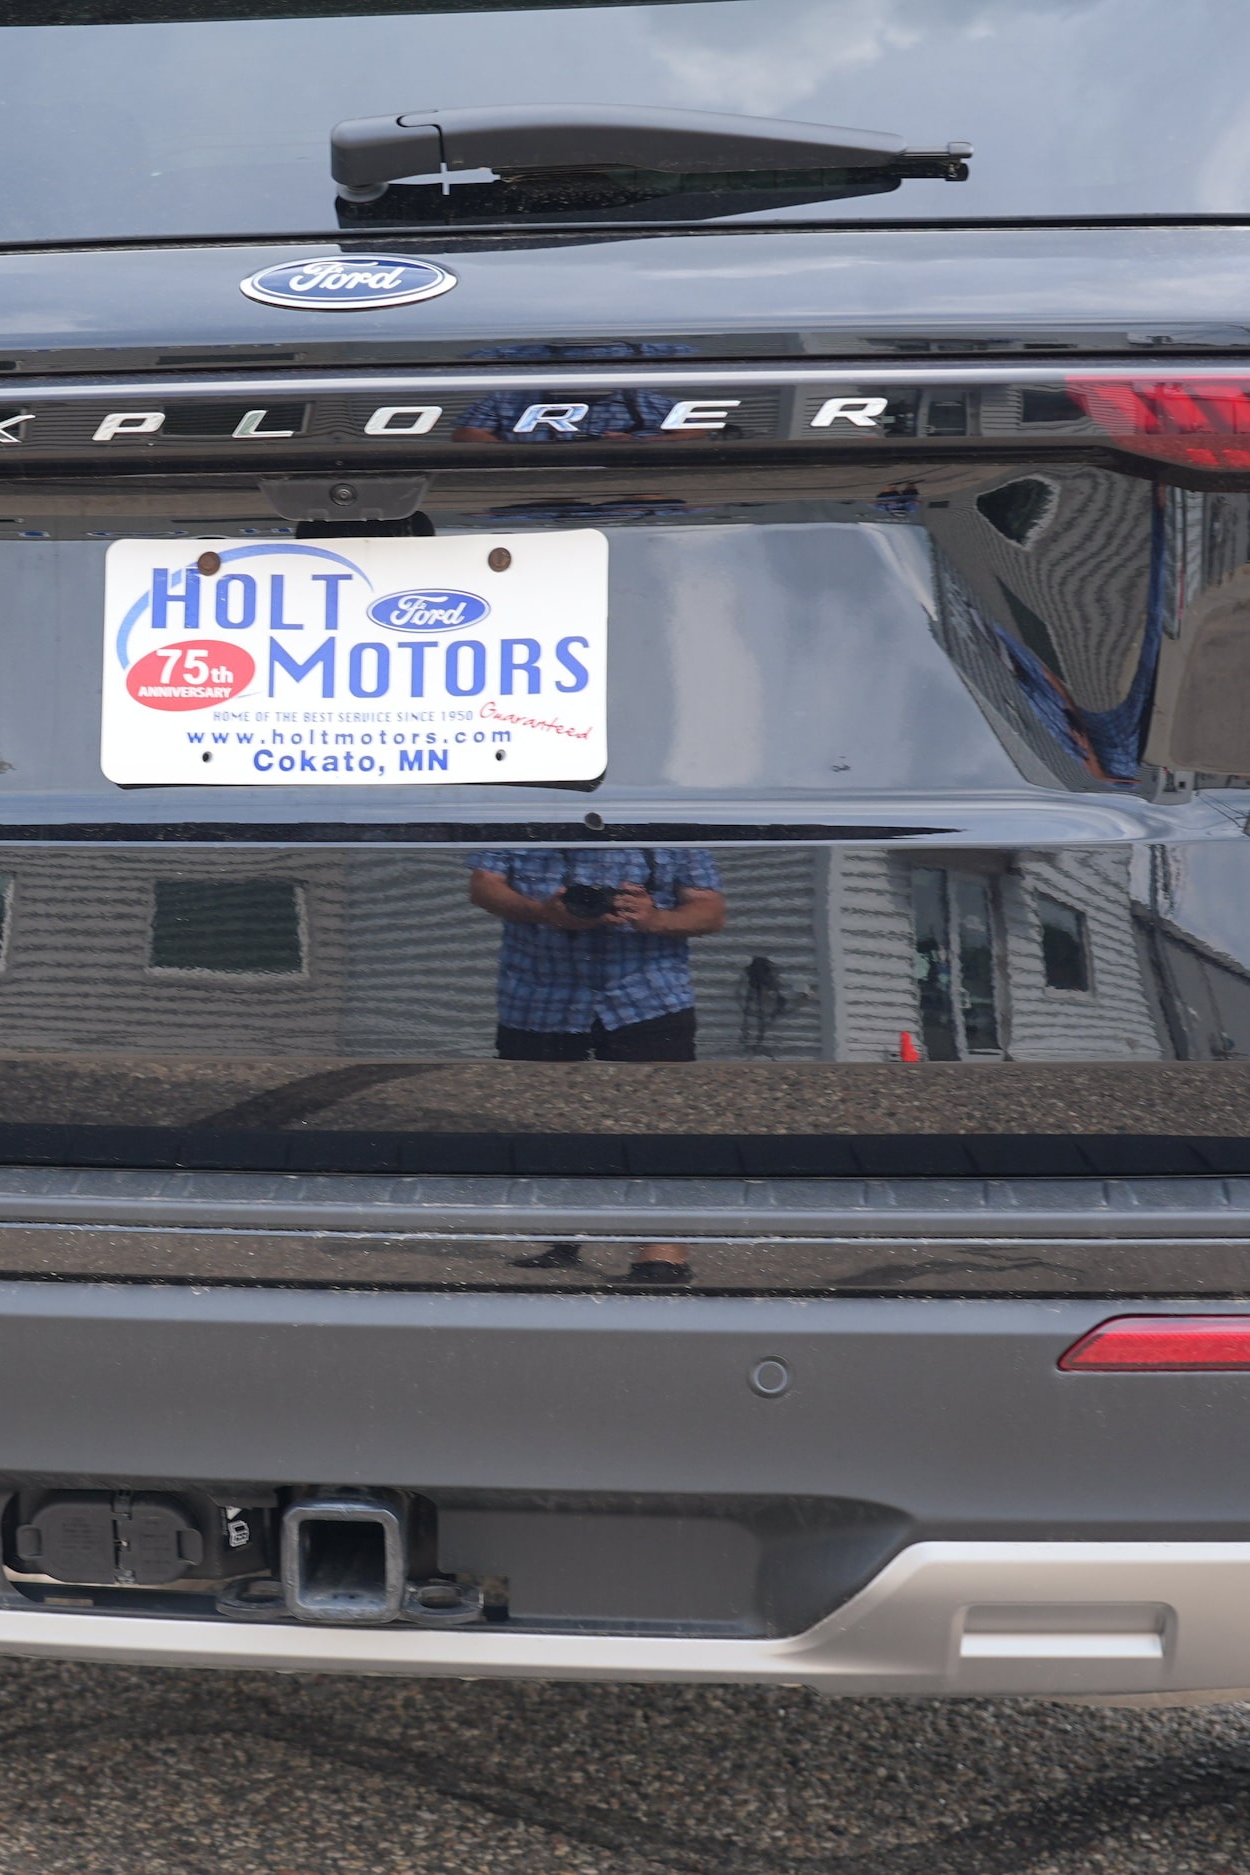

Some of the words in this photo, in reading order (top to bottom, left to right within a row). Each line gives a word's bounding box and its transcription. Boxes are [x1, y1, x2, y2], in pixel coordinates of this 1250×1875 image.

[288, 261, 406, 292] Ford
[152, 568, 353, 630] HOLT
[389, 595, 467, 626] Ford
[156, 649, 234, 685] 75th
[268, 635, 590, 699] MOTORS
[138, 686, 232, 699] ANNIVERSARY
[213, 711, 250, 722] HOME
[255, 711, 269, 722] OF
[276, 711, 298, 722] THE
[303, 711, 333, 723] BEST
[397, 711, 435, 722] SINCE
[441, 710, 473, 721] 1950
[479, 701, 593, 741] Guaranteed
[187, 728, 511, 745] www.holtmotors.com
[253, 748, 386, 776] Cokato,
[399, 749, 449, 771] MN
